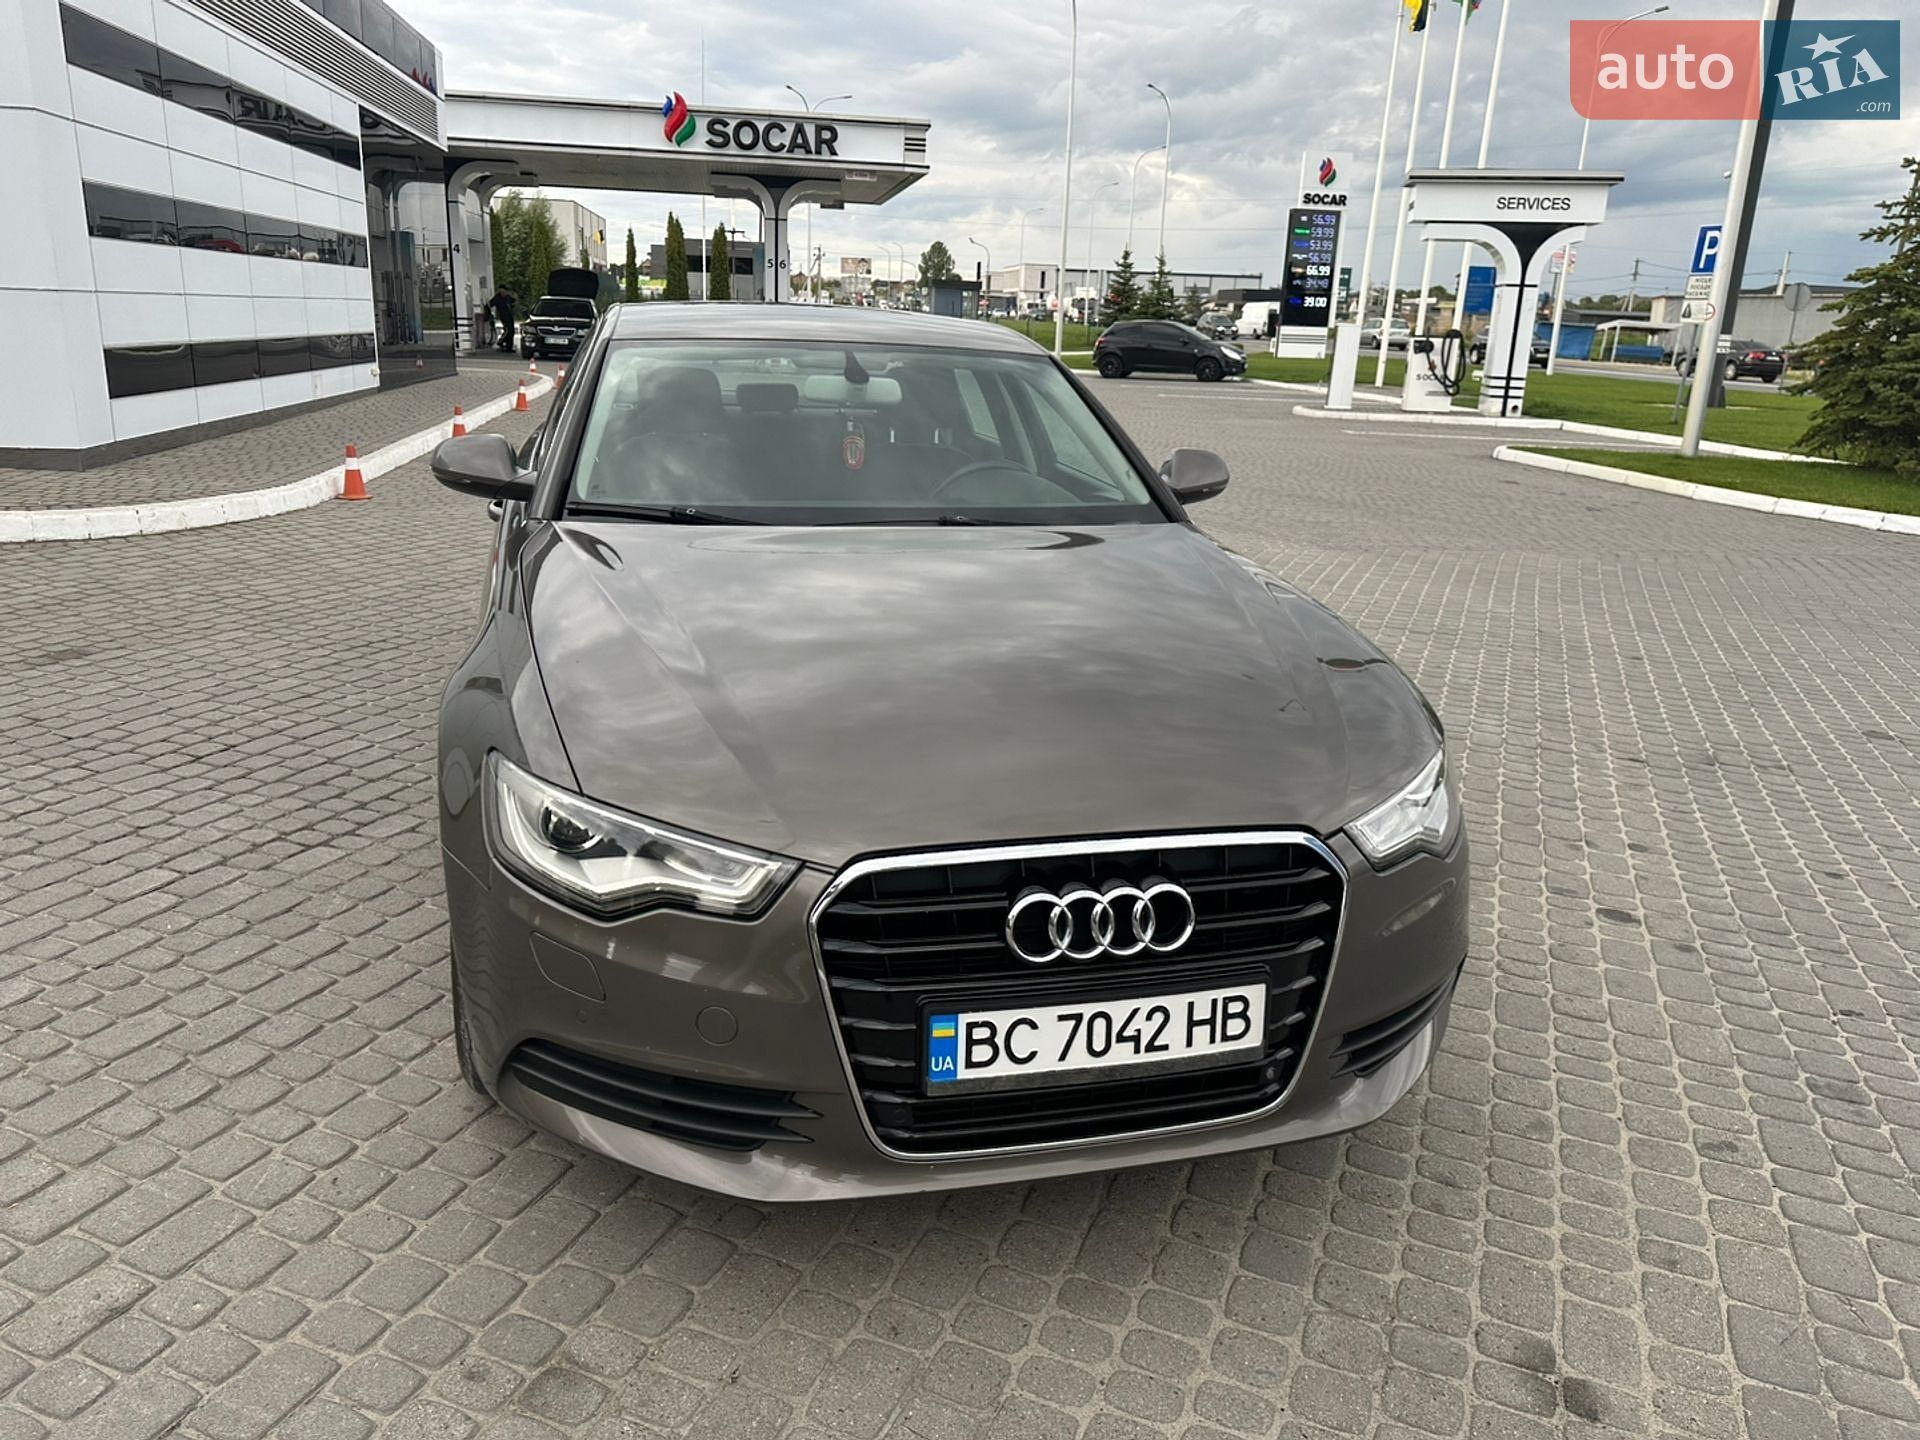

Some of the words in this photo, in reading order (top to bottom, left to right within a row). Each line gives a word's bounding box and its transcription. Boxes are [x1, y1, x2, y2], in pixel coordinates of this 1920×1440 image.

[705, 118, 839, 156] SOCAR
[1303, 193, 1347, 206] SOCAR
[1496, 197, 1571, 211] SERVICES
[454, 244, 460, 253] 4
[1699, 230, 1720, 269] P
[767, 259, 774, 269] 5
[779, 260, 787, 269] 6
[965, 1018, 1039, 1070] BC
[1056, 1005, 1171, 1063] 7042
[1186, 994, 1251, 1048] HB
[931, 1056, 954, 1072] UA
